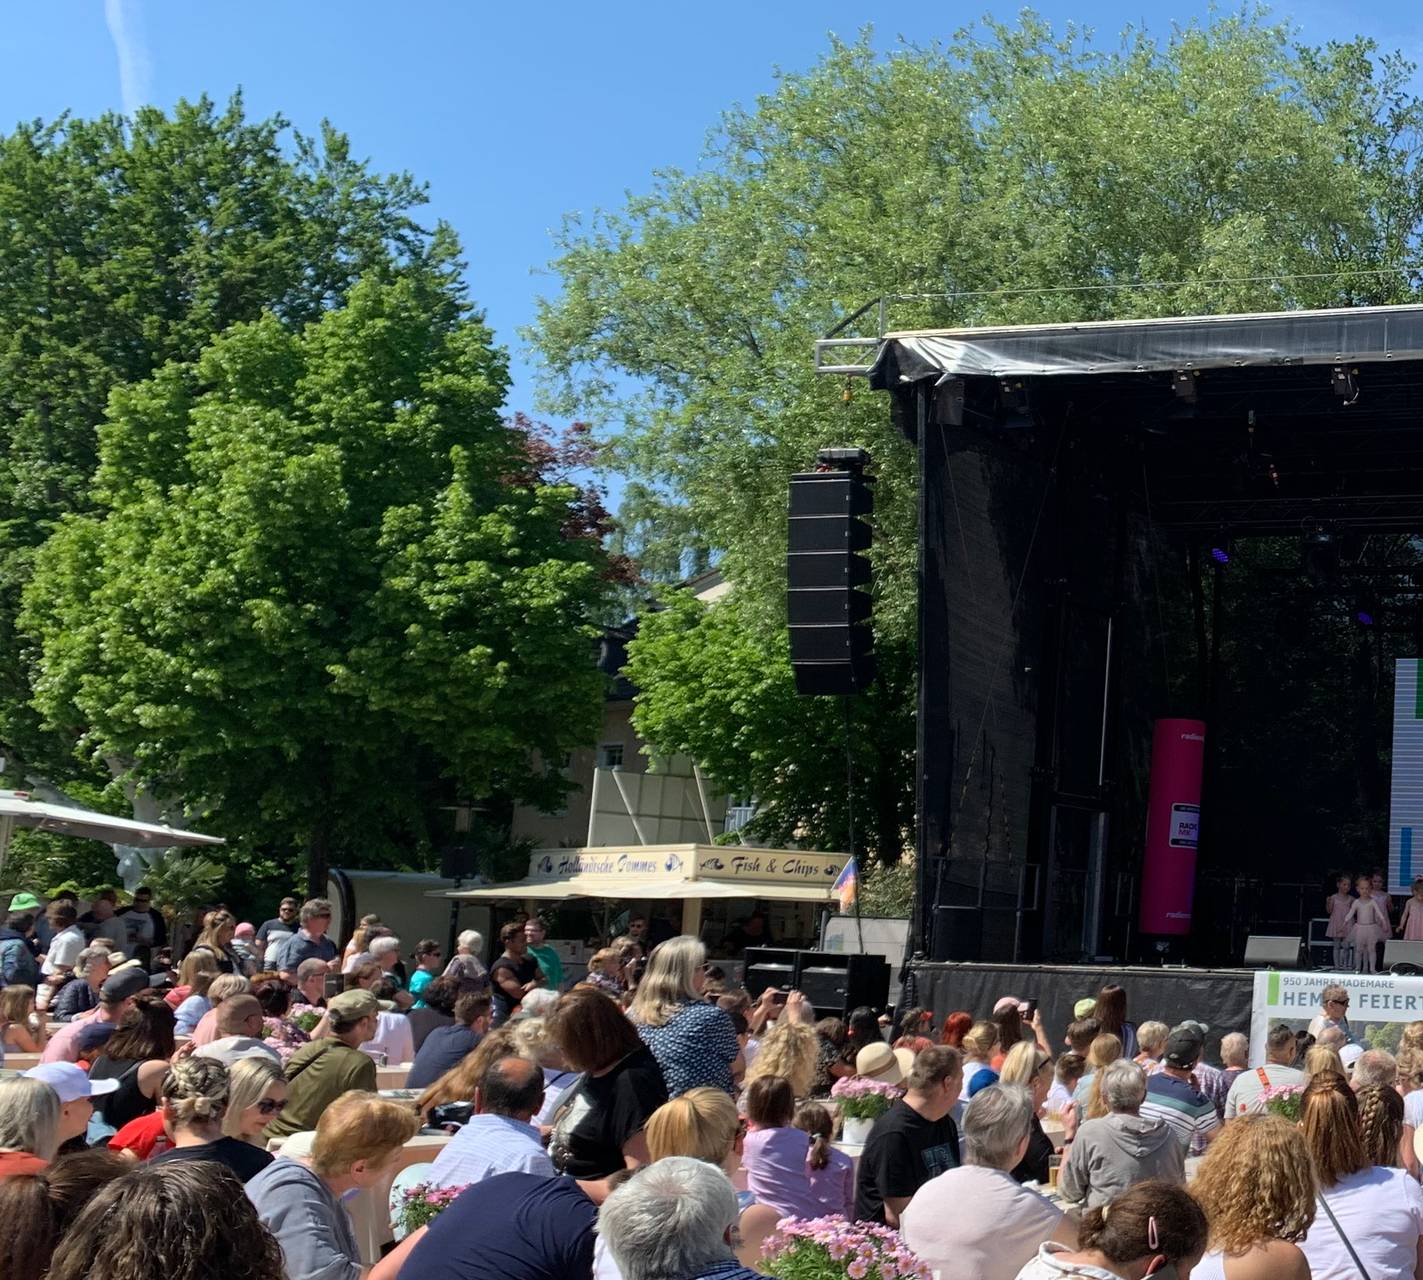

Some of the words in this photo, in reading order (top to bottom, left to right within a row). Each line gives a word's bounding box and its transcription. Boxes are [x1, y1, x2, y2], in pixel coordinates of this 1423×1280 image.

[731, 856, 760, 874] Fish
[766, 858, 776, 873] &
[783, 859, 819, 878] Chips
[1283, 978, 1301, 986] 950
